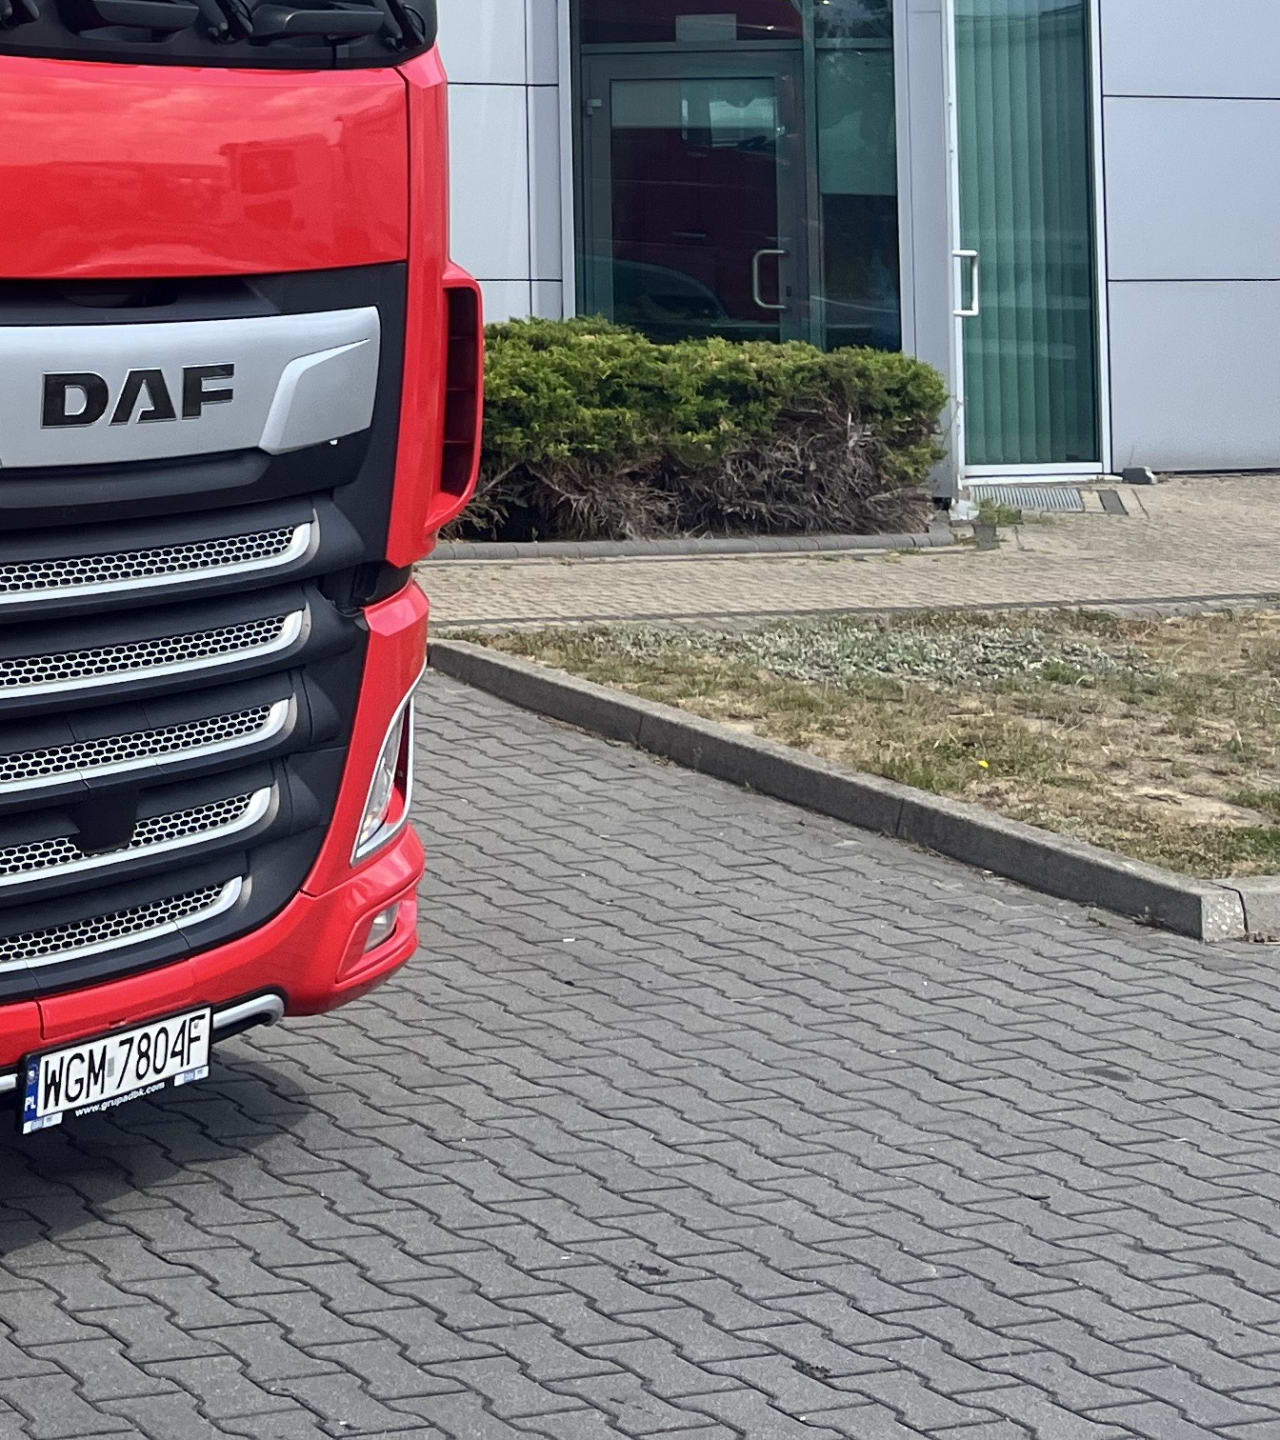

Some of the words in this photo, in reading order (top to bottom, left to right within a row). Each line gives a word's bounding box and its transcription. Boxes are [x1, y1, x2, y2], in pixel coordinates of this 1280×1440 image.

[40, 362, 236, 429] DAF
[42, 1044, 108, 1111] WGM
[116, 1013, 206, 1090] 7804F
[23, 1095, 37, 1112] PL
[74, 1081, 165, 1117] www.grupadbk.com
